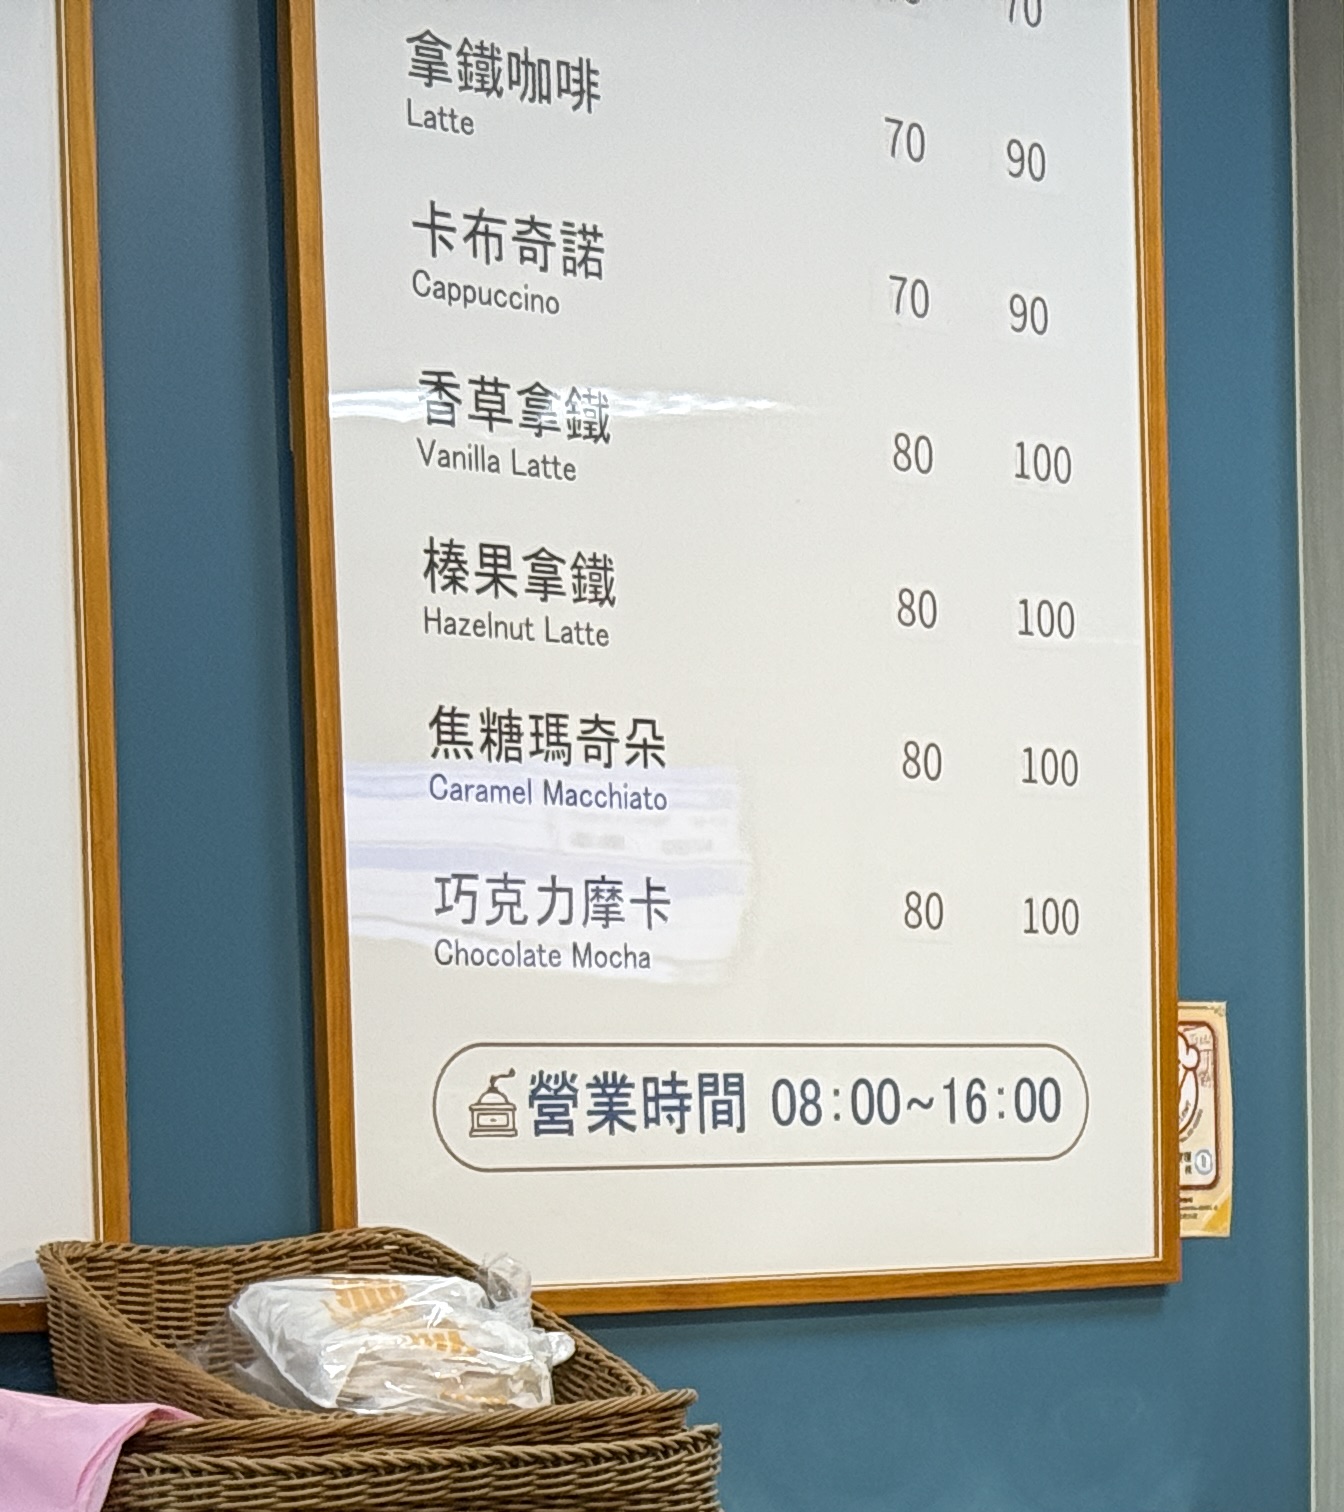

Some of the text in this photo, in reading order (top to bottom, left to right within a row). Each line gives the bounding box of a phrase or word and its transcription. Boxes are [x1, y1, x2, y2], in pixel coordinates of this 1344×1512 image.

[405, 29, 601, 114] 拿鐵咖啡
[406, 97, 475, 136] Latte
[884, 116, 1046, 183] 70 90
[411, 199, 605, 281] 卡布奇諾
[412, 269, 561, 316] Cappuccino
[888, 274, 1049, 336] 70 90
[417, 370, 611, 445] 香草拿鐵
[416, 437, 577, 482] Vanilla Latte
[893, 432, 1072, 485] 80 100
[422, 535, 617, 608] 榛果拿鐵
[423, 605, 610, 648] Hazelnut Latte
[897, 587, 1075, 640] 80 100
[428, 704, 667, 771] 焦糖瑪奇朵
[902, 740, 1079, 787] 80 100
[429, 773, 668, 811] Caramel Macchiato
[434, 871, 671, 931] 巧克力摩卡
[904, 890, 1080, 936] 80 100
[434, 938, 651, 969] Chocolate Mocha
[528, 1069, 1062, 1138] 營業時間 08:00~16:00
